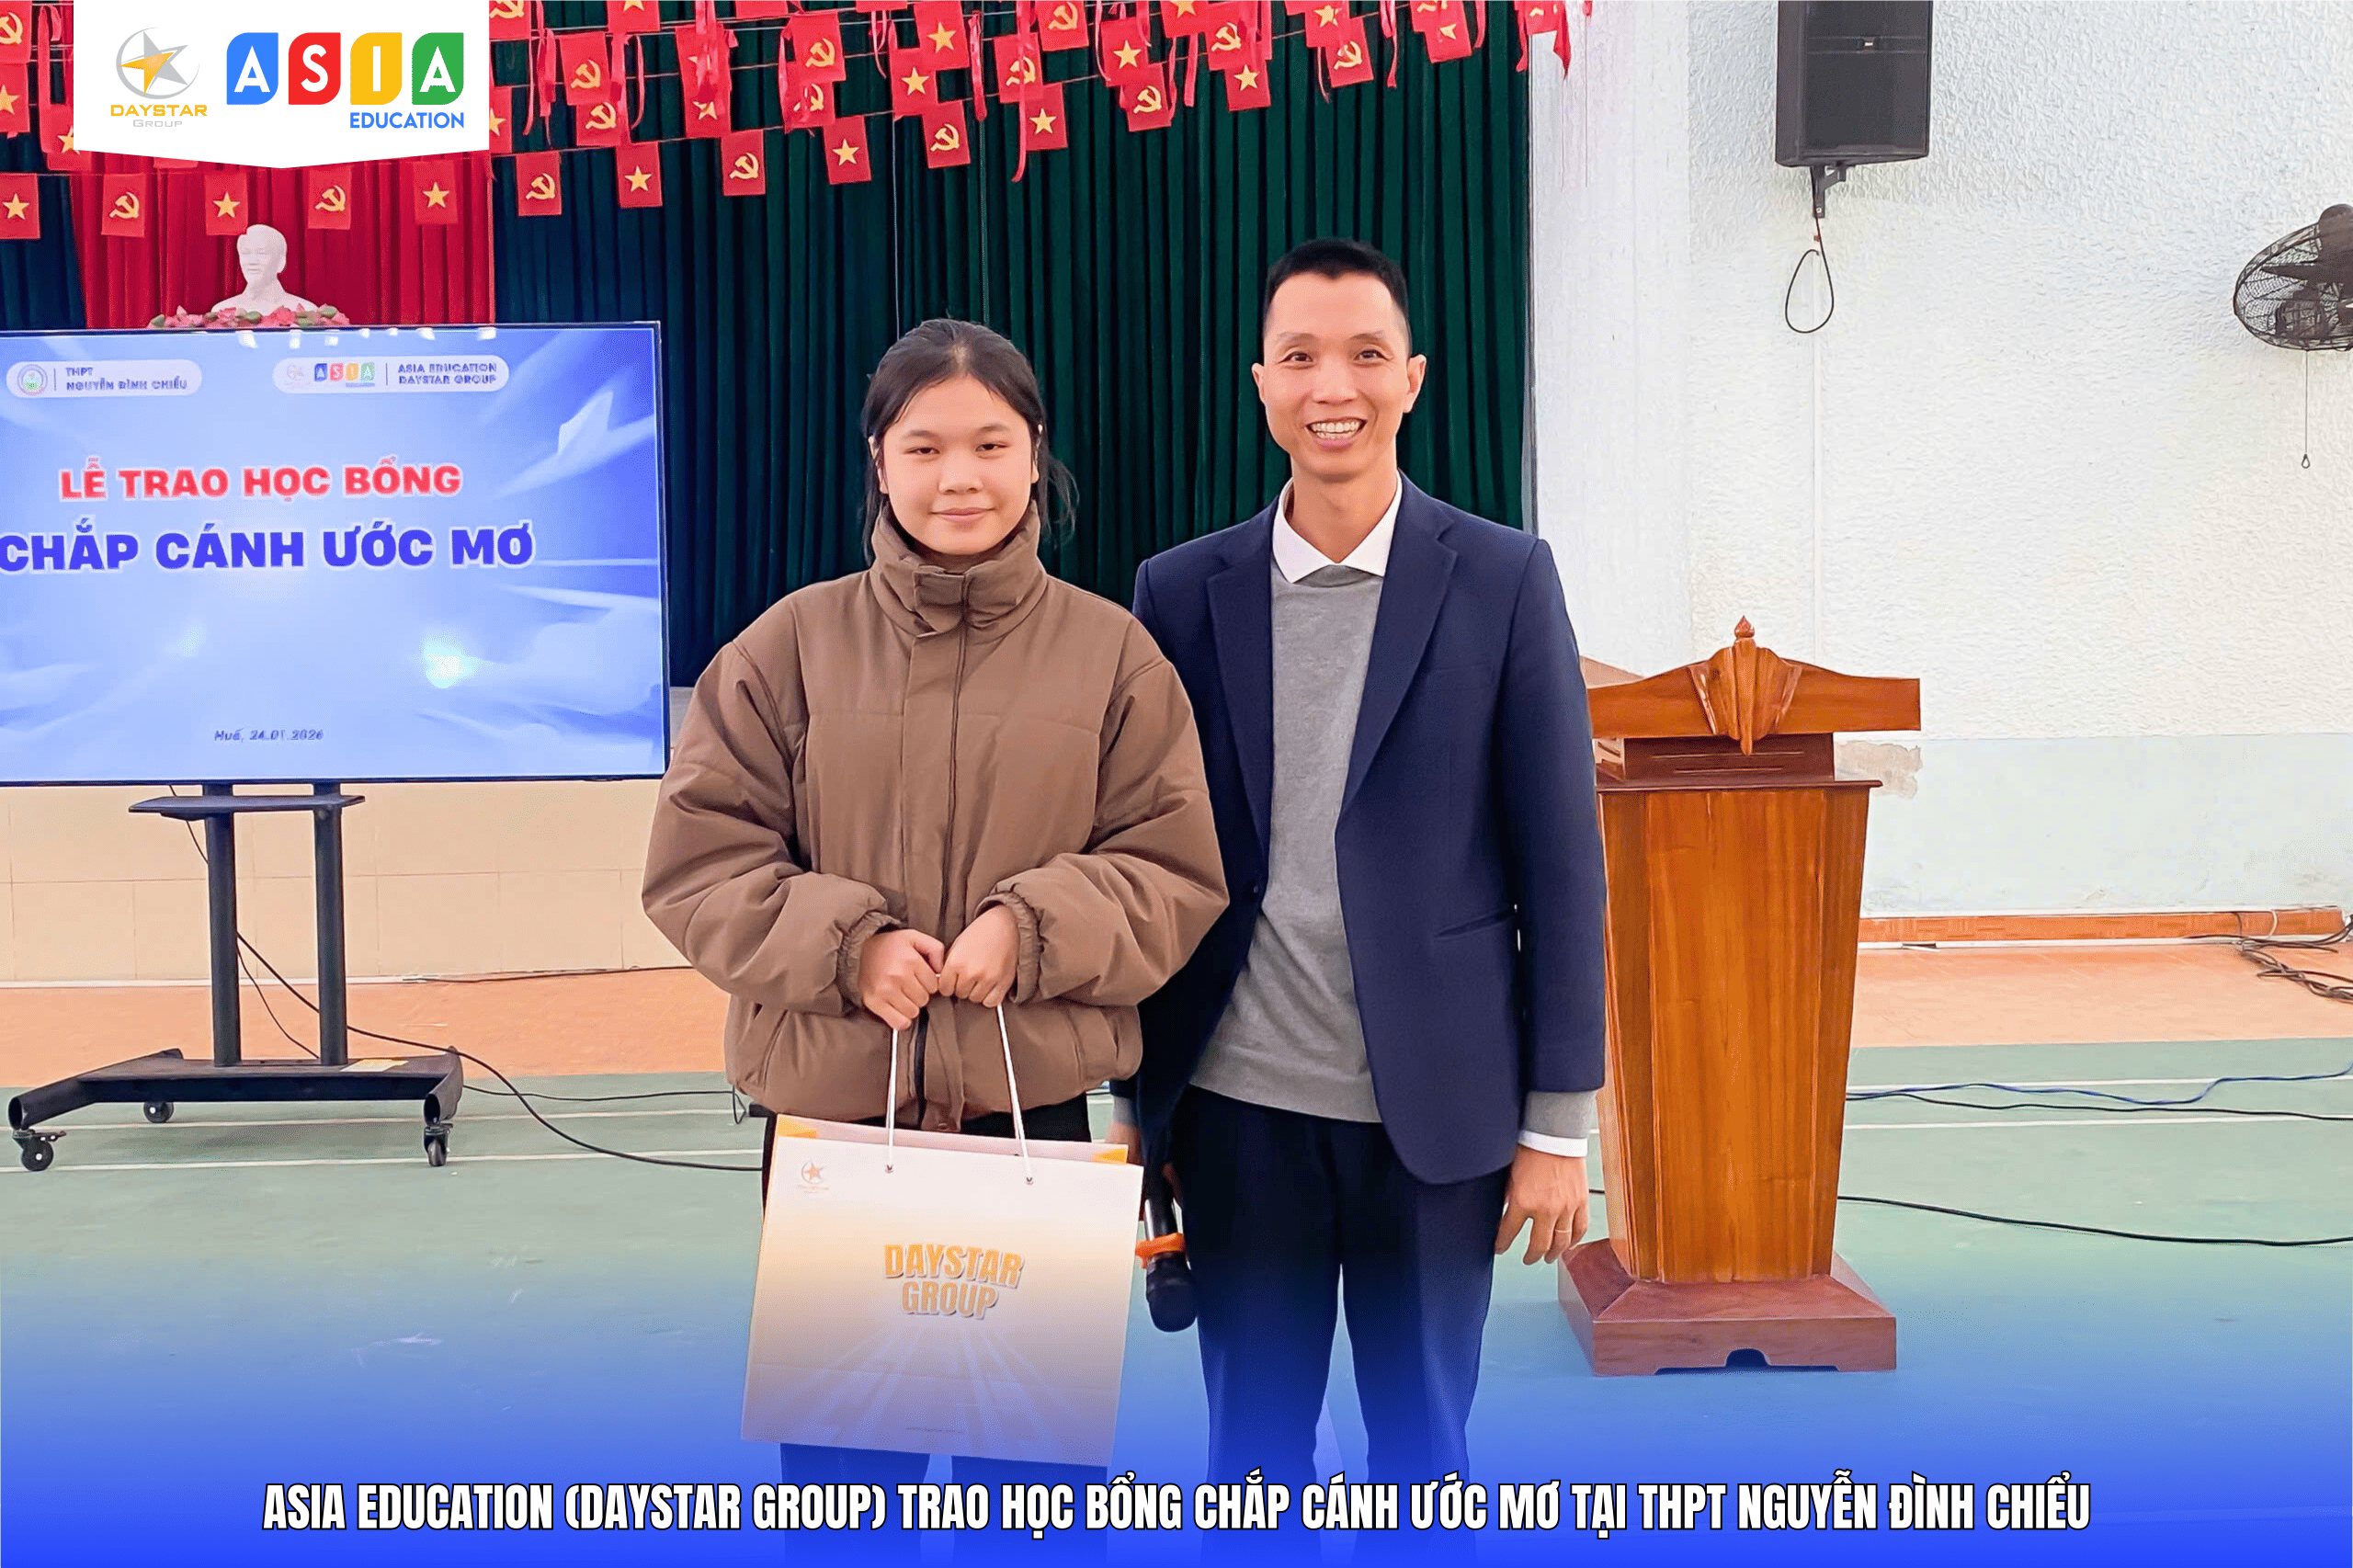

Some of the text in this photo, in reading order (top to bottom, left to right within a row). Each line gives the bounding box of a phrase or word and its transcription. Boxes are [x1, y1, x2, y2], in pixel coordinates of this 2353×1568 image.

[65, 367, 94, 377] THPT
[398, 362, 497, 374] ASIA EDUCATION
[398, 374, 497, 385] DAYSTAR GROUP
[61, 455, 461, 503] LỄ TRAO HỌC BỔNG
[0, 517, 532, 572] CHẮP CÁNH ƯỚC MƠ
[883, 1243, 1025, 1289] DAYSTAR
[902, 1280, 998, 1320] GROUP
